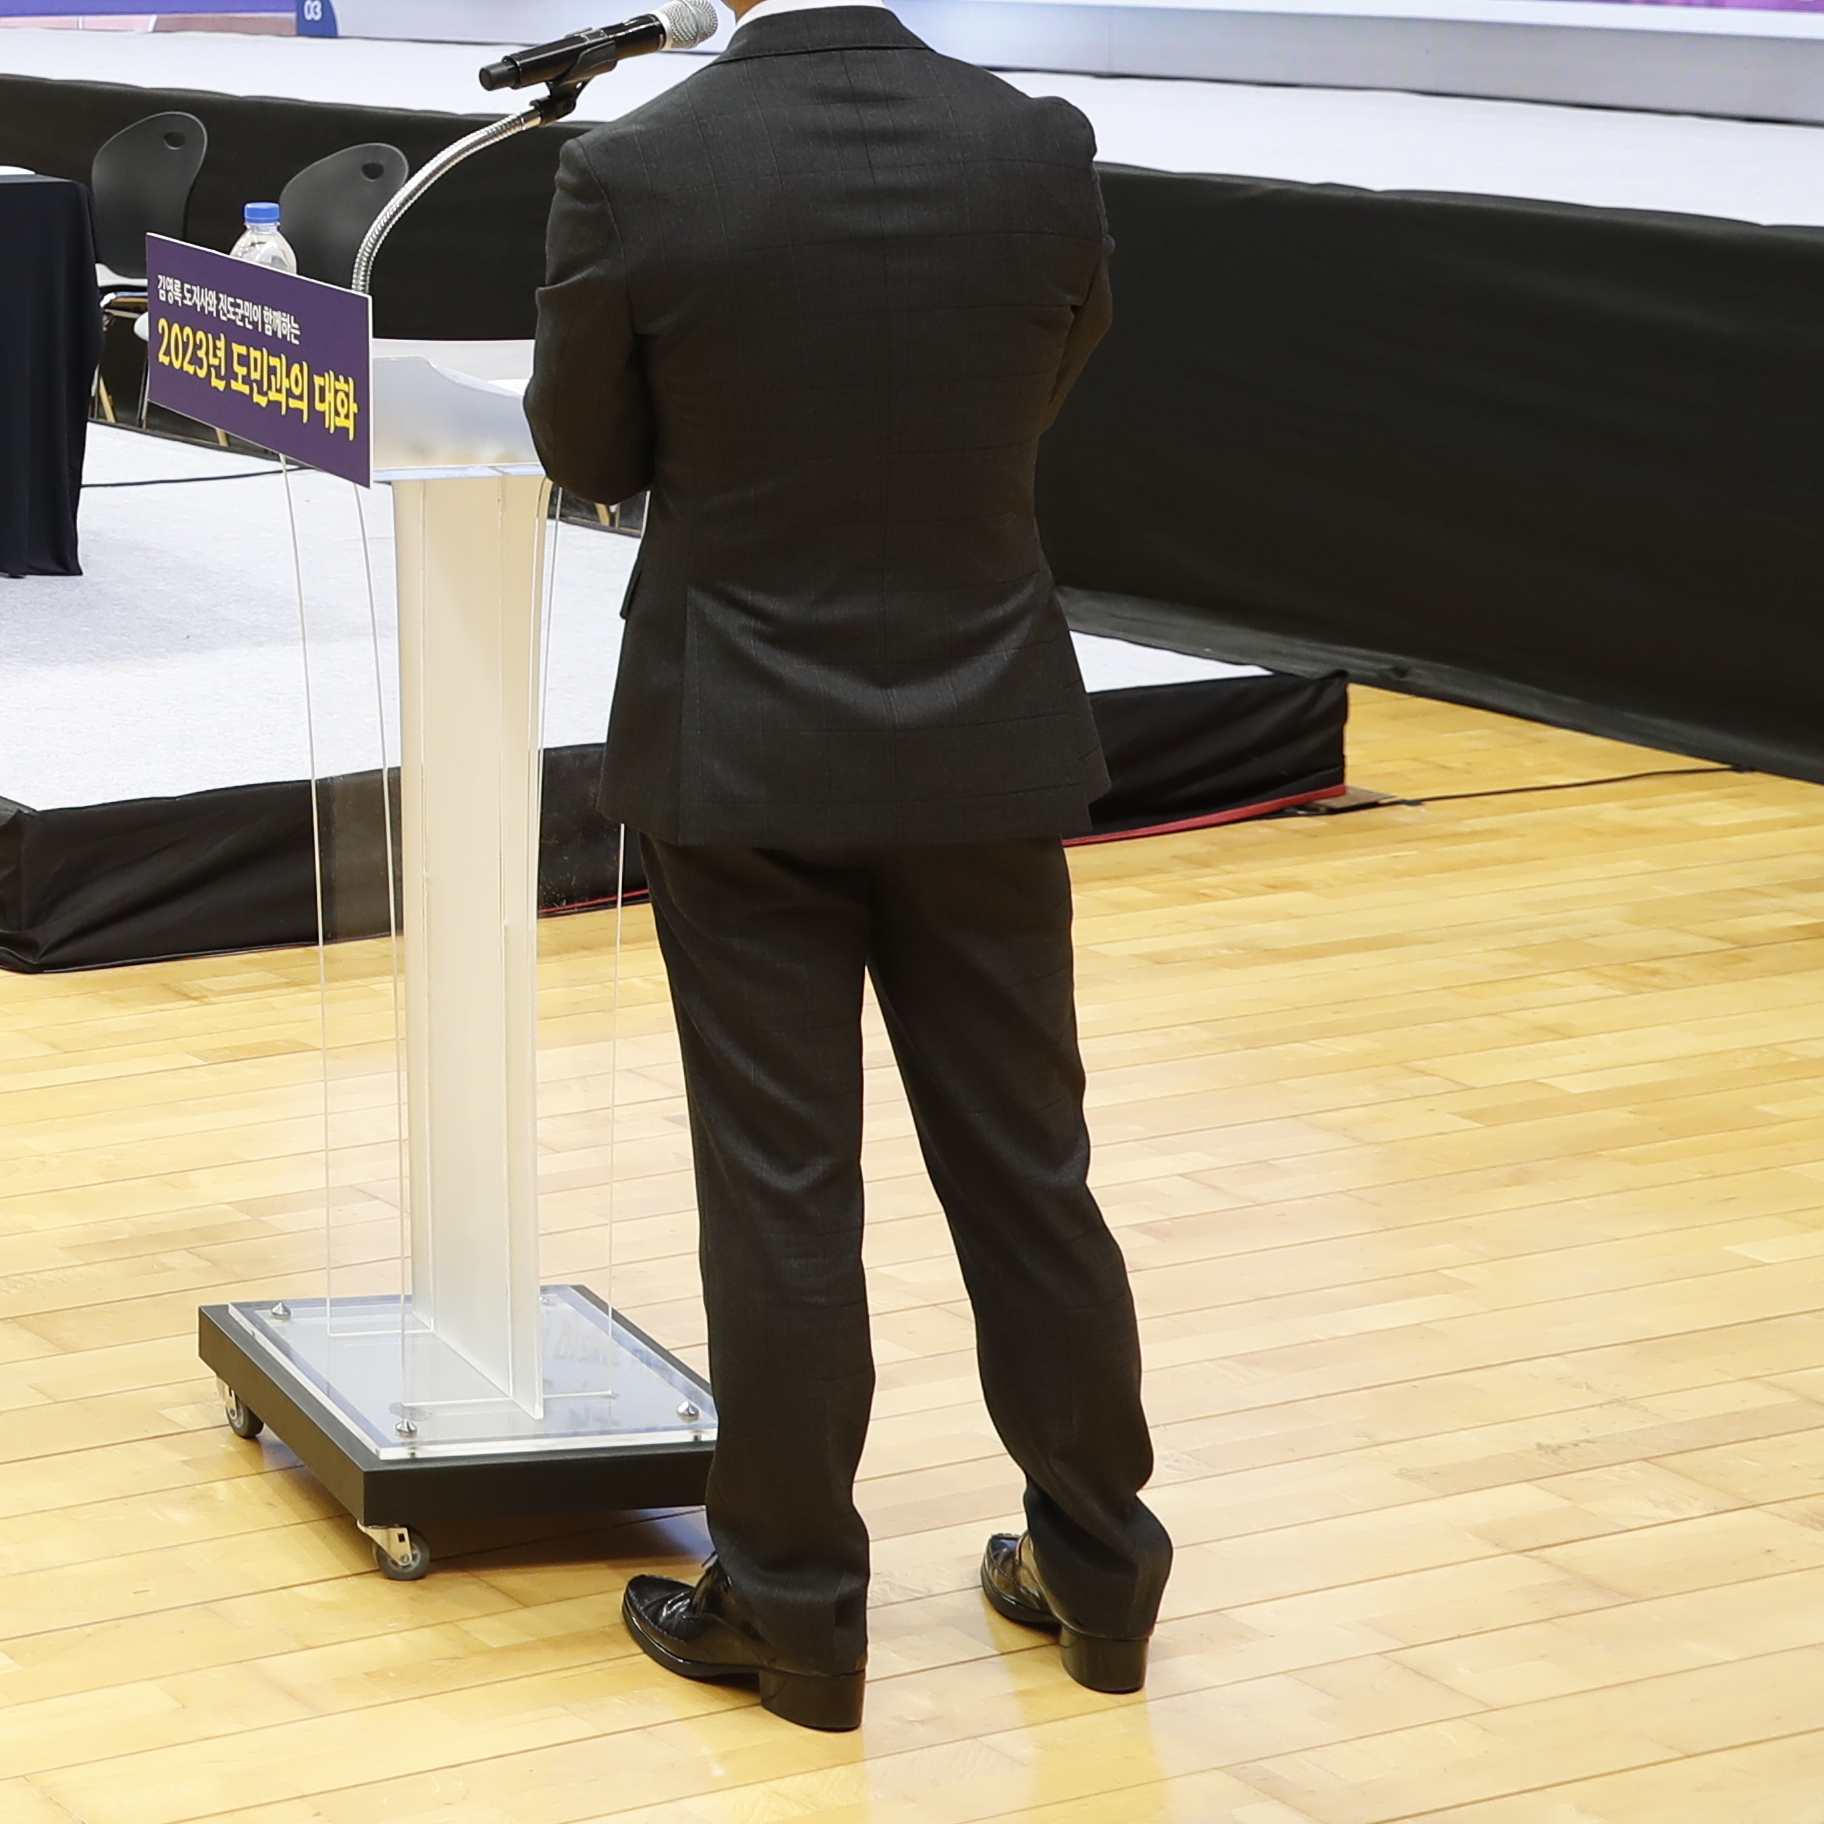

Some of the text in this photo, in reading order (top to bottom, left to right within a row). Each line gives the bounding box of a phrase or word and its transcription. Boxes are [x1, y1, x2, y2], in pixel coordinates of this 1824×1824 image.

[156, 273, 301, 346] 김영록 도지사와 진도군민이 함께하는
[158, 317, 359, 441] 2023년 도민과의 대화
